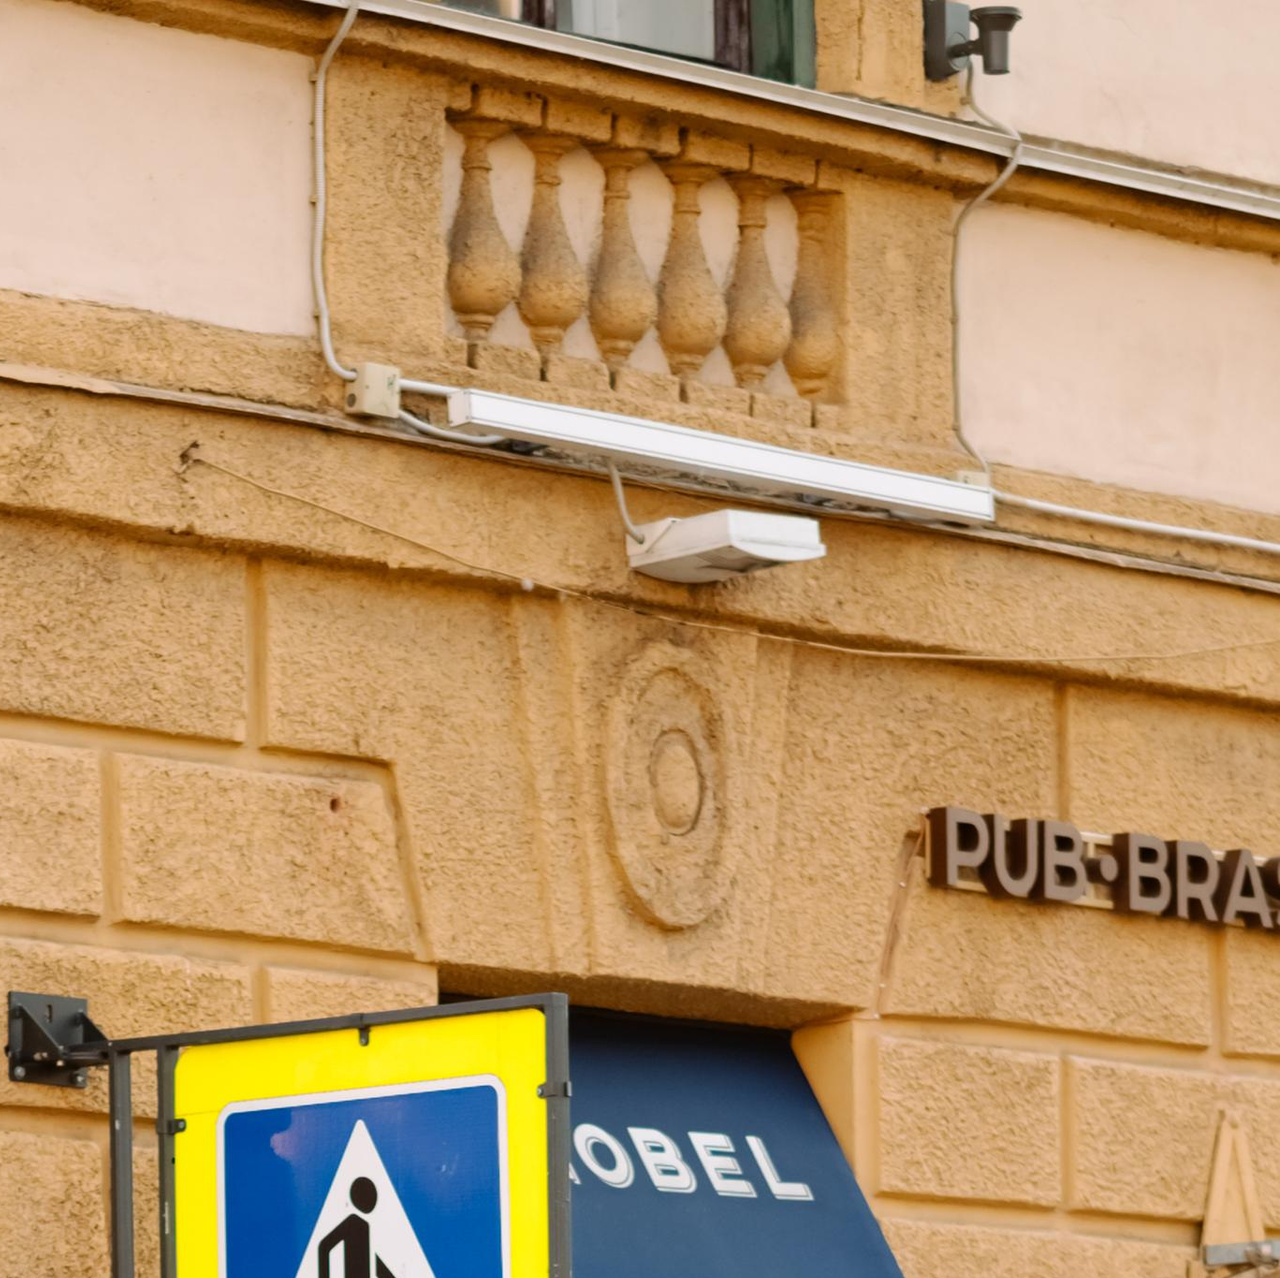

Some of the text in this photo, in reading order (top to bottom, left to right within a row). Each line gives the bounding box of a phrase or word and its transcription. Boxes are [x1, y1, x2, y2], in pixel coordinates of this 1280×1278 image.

[931, 805, 1280, 932] PUB BRA
[569, 1122, 814, 1202] OBEL
